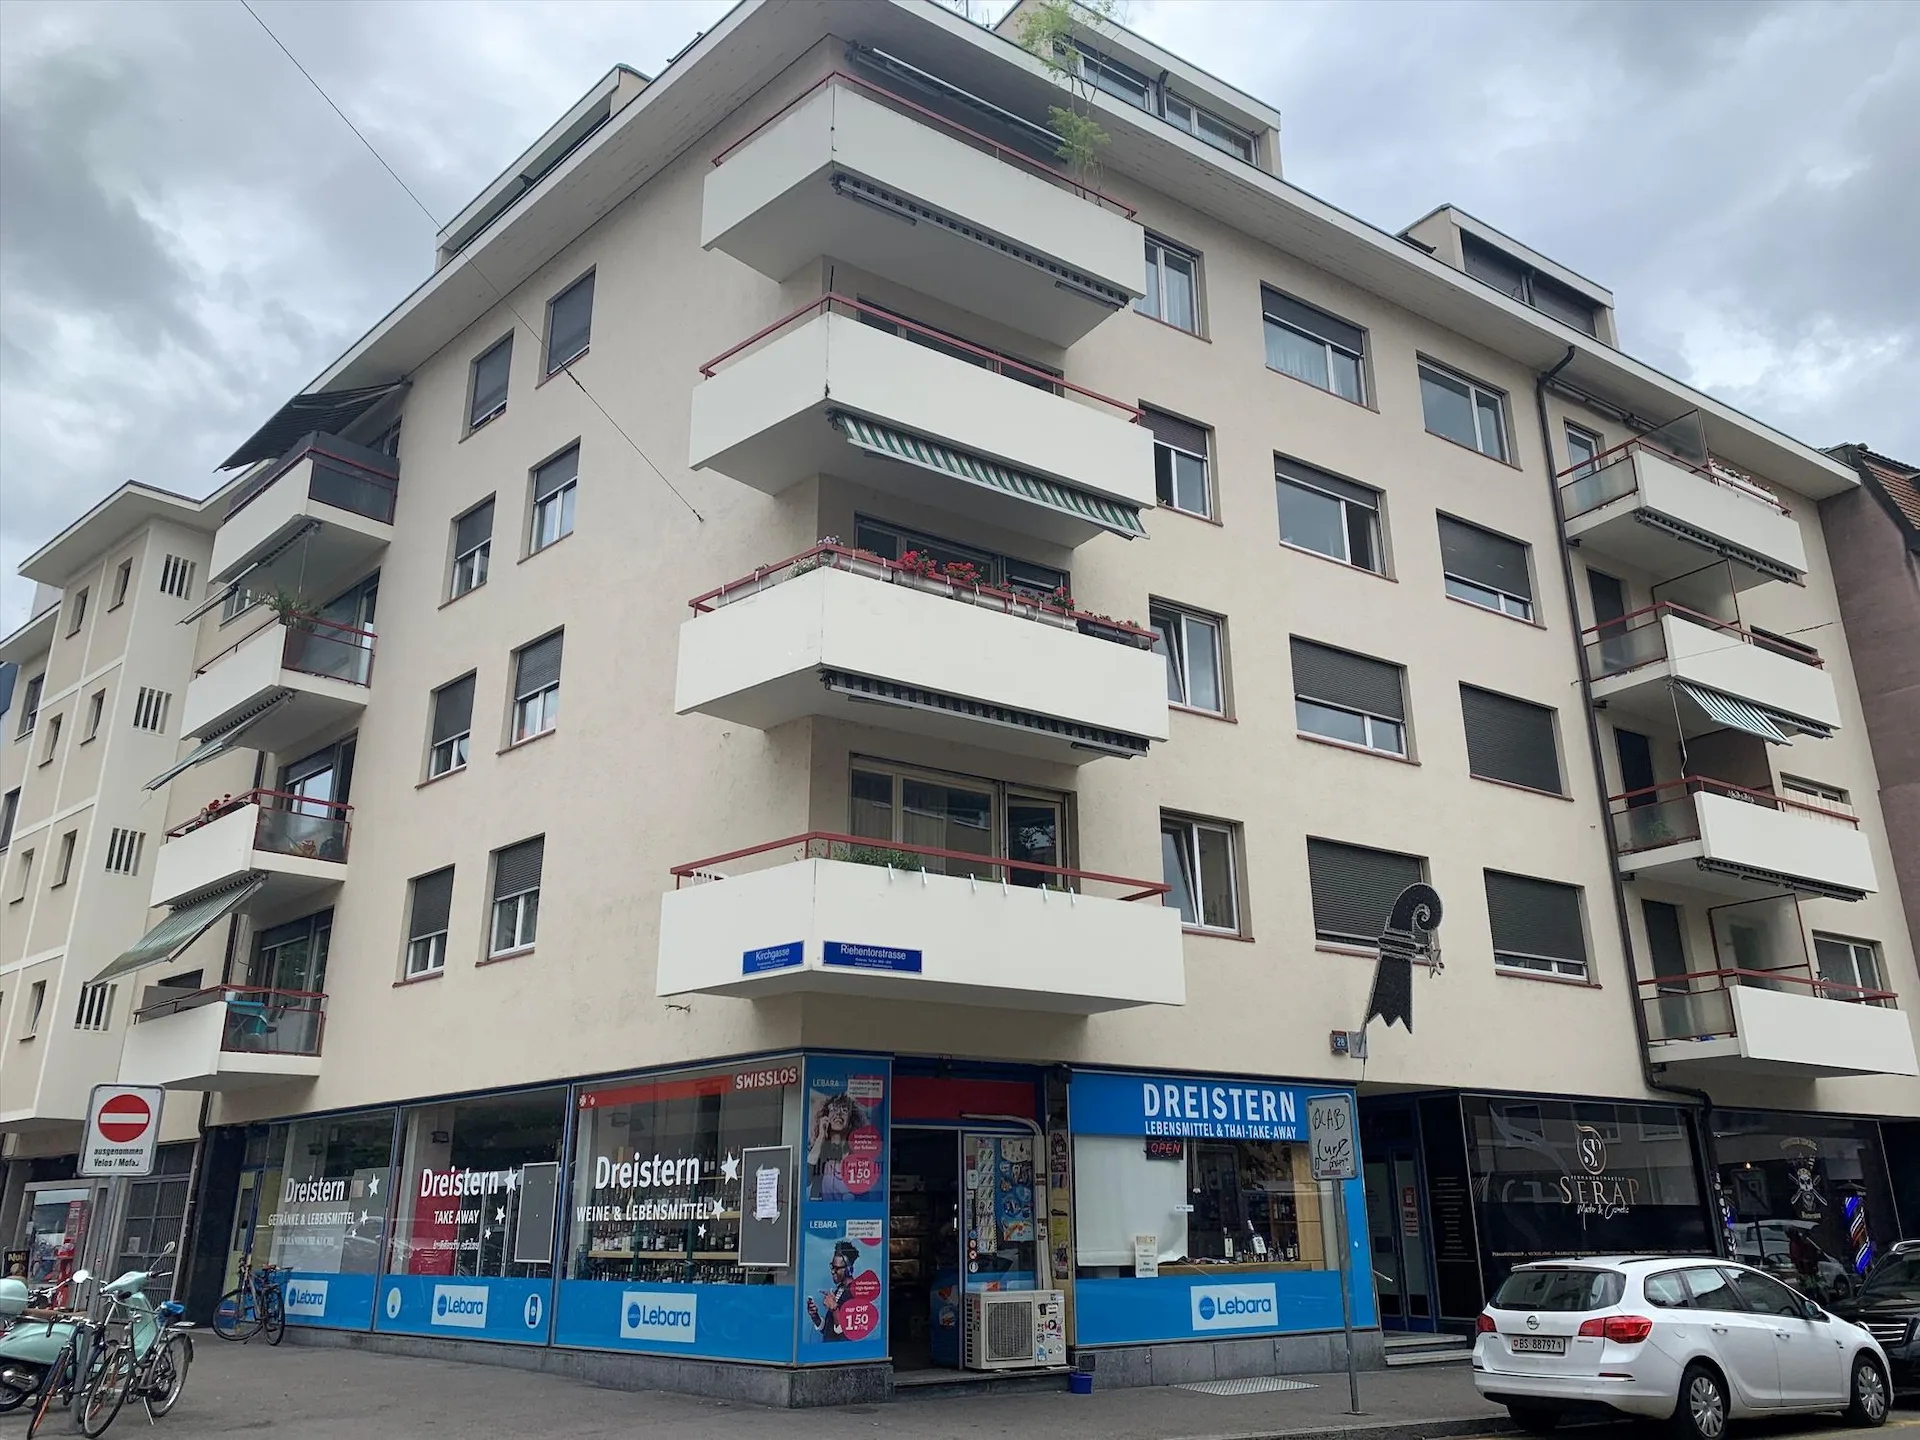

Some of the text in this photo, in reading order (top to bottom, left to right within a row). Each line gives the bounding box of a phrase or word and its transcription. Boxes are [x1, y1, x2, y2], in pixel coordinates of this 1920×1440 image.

[755, 947, 790, 961] Kirchgasse
[840, 944, 907, 961] Riehentorstrasse
[736, 1068, 797, 1089] SWISSLOS
[813, 1079, 840, 1087] LEBARA
[1143, 1083, 1296, 1122] DREISTERN
[1145, 1121, 1214, 1137] LEBENSMITTEL
[1216, 1123, 1223, 1137] &
[94, 1148, 144, 1156] ausgenommen
[1150, 1142, 1181, 1154] OPEN
[94, 1159, 112, 1167] Velos
[595, 1152, 699, 1189] Dreistern
[284, 1175, 345, 1202] Dreistern
[420, 1165, 499, 1197] Dreistern
[1560, 1176, 1640, 1205] SERAP
[268, 1212, 355, 1226] GETRÄNKE & LEBENSMITTEL
[434, 1209, 480, 1224] TAKE AWAY
[576, 1203, 709, 1222] WEINE & LEBENSMITTEL
[809, 1220, 838, 1229] LEBARA
[297, 1290, 324, 1305] Lebara
[448, 1296, 484, 1315] Lebara
[1217, 1296, 1272, 1315] Lebara
[642, 1304, 691, 1327] Lebara
[1519, 1339, 1556, 1350] BS 88797
